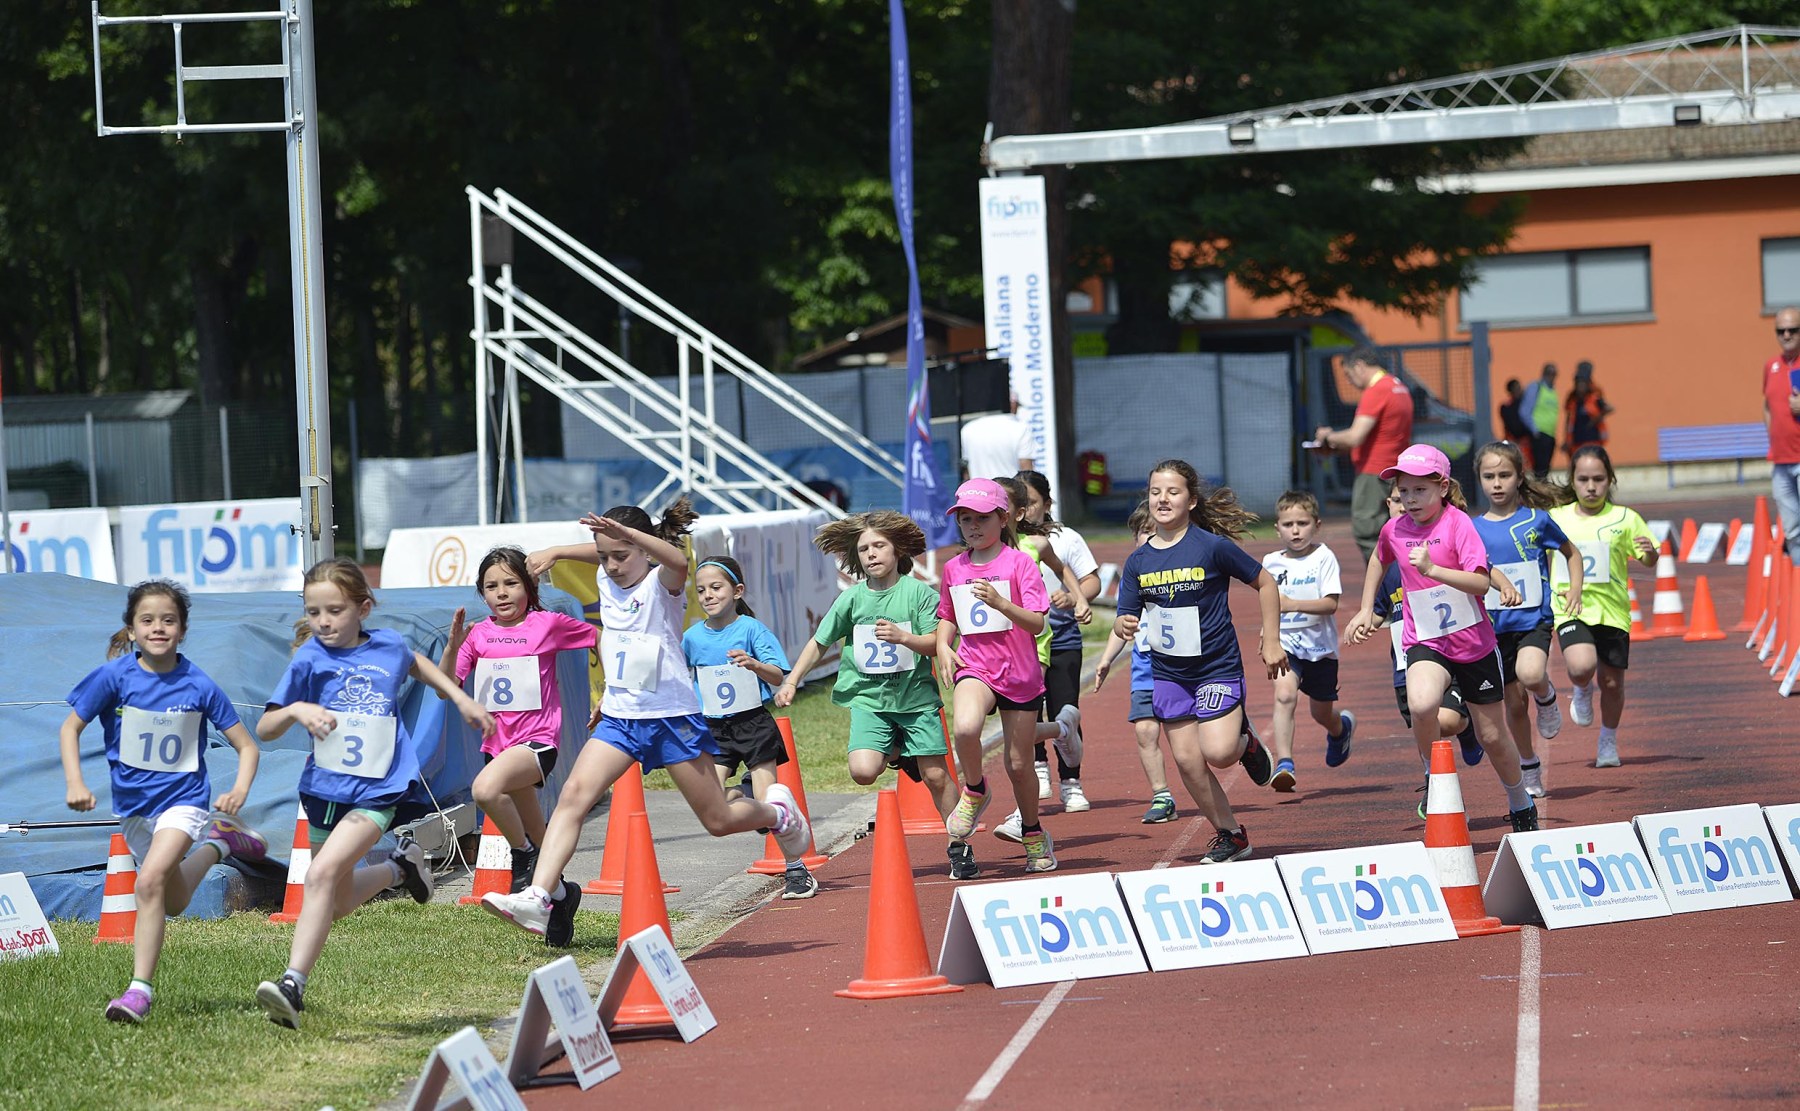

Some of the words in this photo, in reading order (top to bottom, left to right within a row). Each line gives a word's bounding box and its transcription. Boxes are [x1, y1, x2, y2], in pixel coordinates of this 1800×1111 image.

[1024, 273, 1042, 371] Moderno
[970, 601, 988, 627] 6
[1433, 602, 1457, 630] 2
[1161, 625, 1175, 649] 5
[615, 651, 626, 681] 1
[864, 642, 899, 668] 23
[493, 677, 514, 705] 8
[716, 682, 737, 709] 9
[1196, 691, 1223, 711] 20
[139, 732, 182, 765] 10
[341, 735, 364, 767] 3
[1657, 827, 1776, 892] fipm
[1530, 844, 1652, 907] fipm
[1676, 887, 1705, 897] Federazione
[1717, 883, 1734, 891] Italiana
[1734, 881, 1759, 889] Pentathlon
[1759, 878, 1780, 887] Moderno
[1299, 866, 1439, 932] fipm
[1552, 903, 1582, 911] Federazione
[1594, 899, 1611, 907] Italiana
[1611, 896, 1636, 905] Pentathlon
[1637, 893, 1658, 902] Moderno
[1142, 884, 1289, 949] fipm
[1319, 927, 1353, 936] Federazione
[1367, 922, 1388, 931] Italiana
[1388, 919, 1418, 929] Pentathlon
[1419, 917, 1444, 926] Moderno
[982, 899, 1128, 965] fipm
[1162, 943, 1198, 953] Federazione
[1213, 939, 1235, 948] Italiana
[1235, 936, 1267, 946] Pentathlon
[1267, 933, 1294, 942] Moderno
[1002, 959, 1038, 969] Federazione
[1053, 955, 1075, 964] Italiana
[1075, 951, 1107, 962] Pentathlon
[1107, 949, 1133, 959] Moderno
